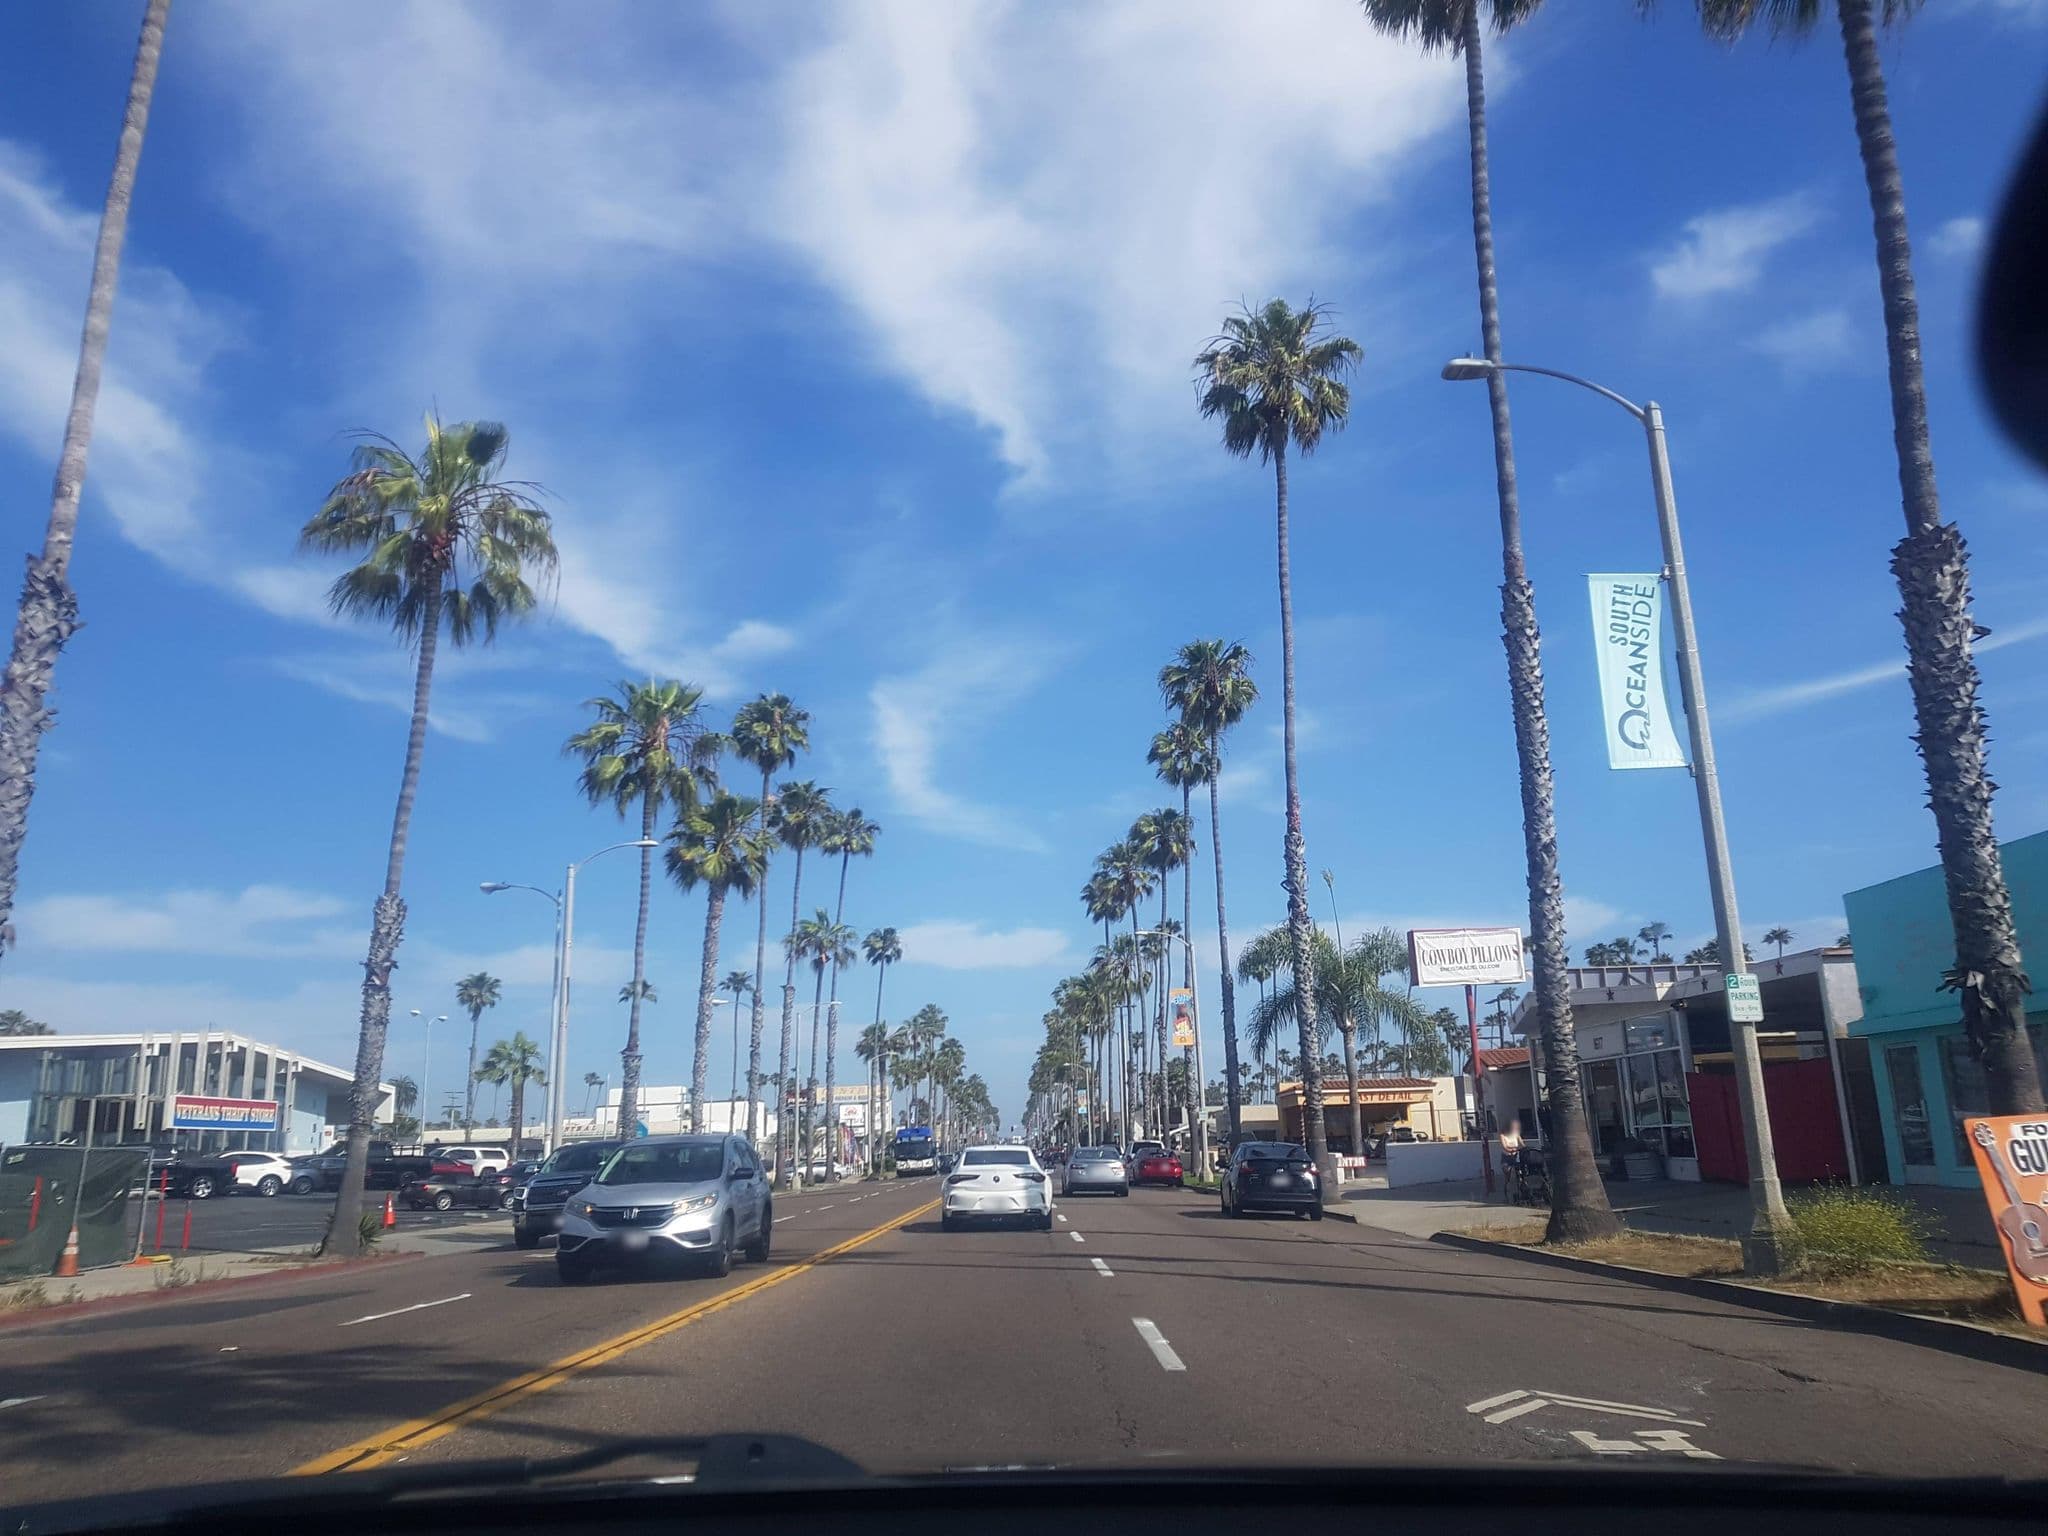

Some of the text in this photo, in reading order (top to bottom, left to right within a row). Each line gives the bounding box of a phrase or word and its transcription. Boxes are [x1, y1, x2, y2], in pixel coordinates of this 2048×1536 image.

[1609, 583, 1634, 646] SOUTH
[1618, 583, 1655, 757] OCEANSIDE
[1421, 944, 1520, 967] COWBOY PILLOWS
[1729, 976, 1738, 988] 2
[1730, 991, 1760, 1001] PARKING
[1342, 1092, 1412, 1103] CAST DETAIL
[176, 1104, 275, 1123] VETERANS THRIFT STORE
